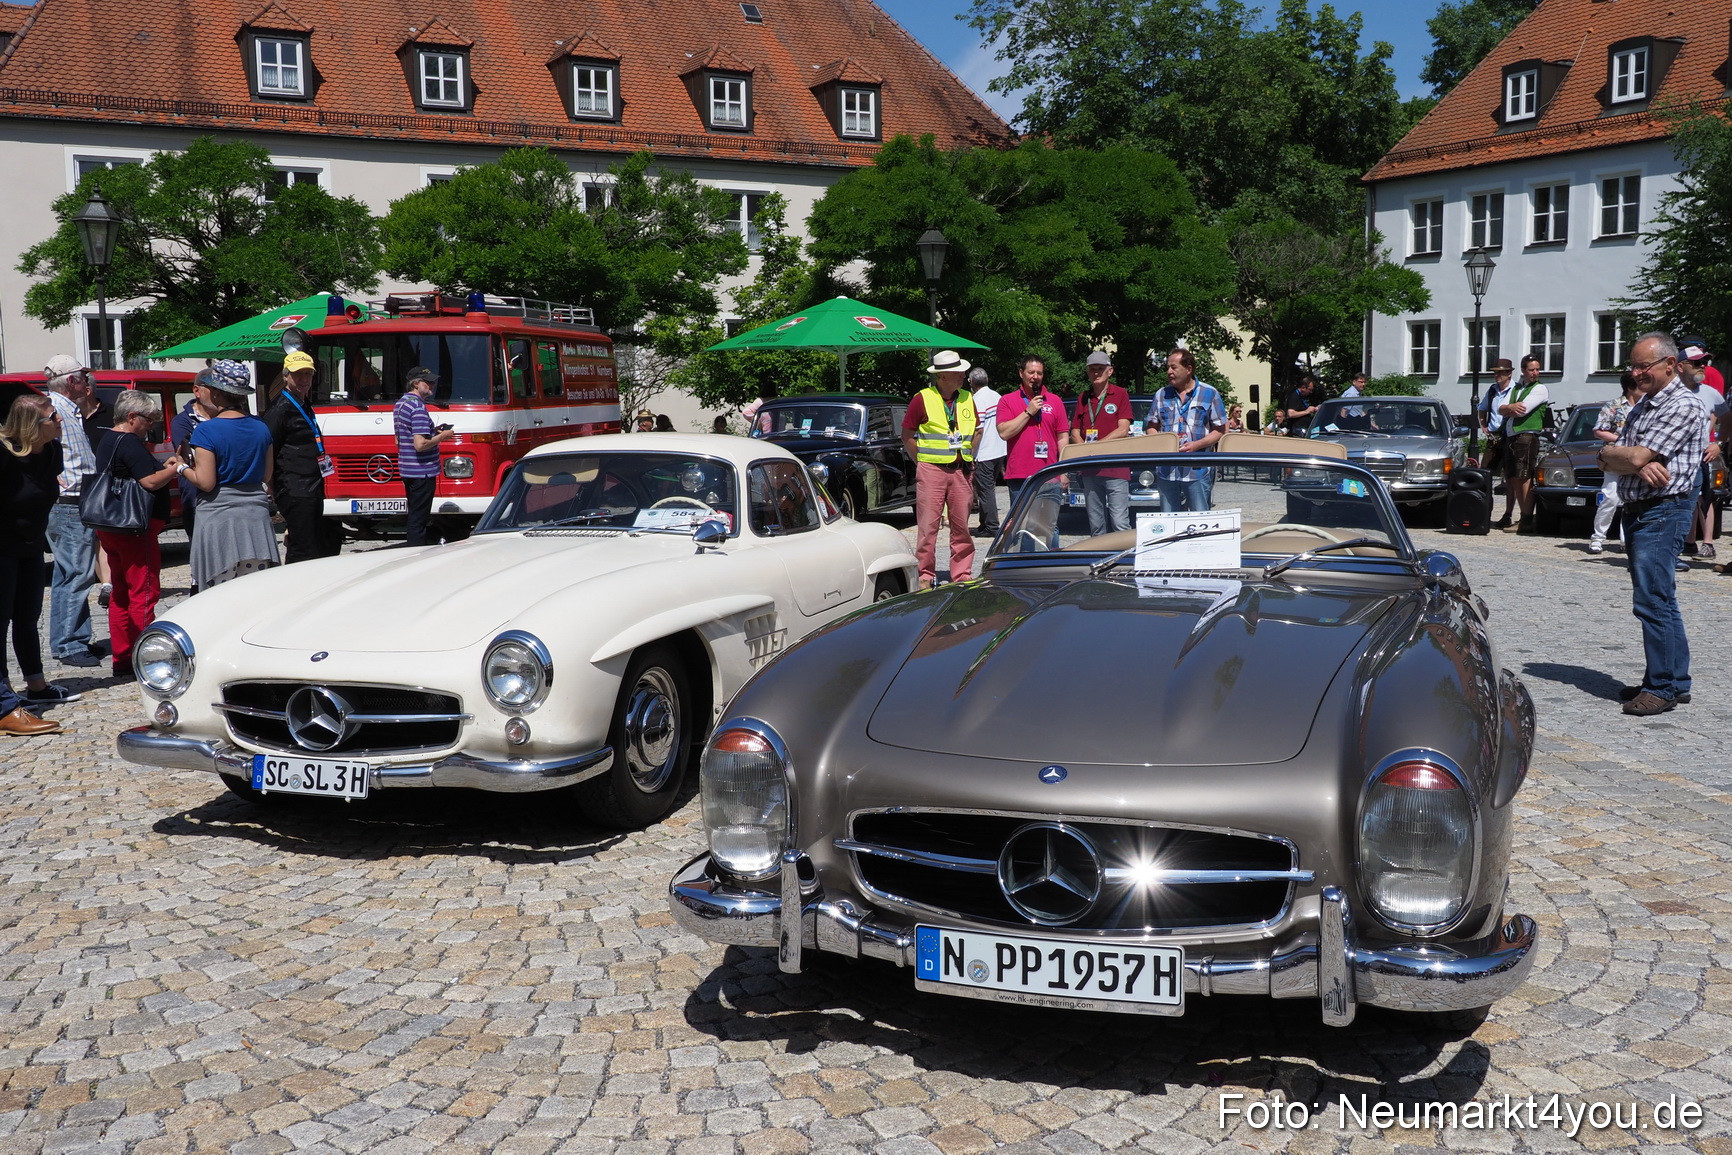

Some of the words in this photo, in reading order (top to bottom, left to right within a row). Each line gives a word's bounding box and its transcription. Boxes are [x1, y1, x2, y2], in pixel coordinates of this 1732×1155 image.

[849, 335, 930, 343] Lammsbräu
[576, 344, 592, 356] MOTOR
[592, 346, 609, 357] MUSEUM
[357, 502, 363, 510] N
[256, 775, 262, 783] D
[265, 760, 289, 787] SC
[924, 959, 934, 971] D
[943, 936, 965, 977] N
[998, 994, 1094, 1009] www.hk-engineering.com
